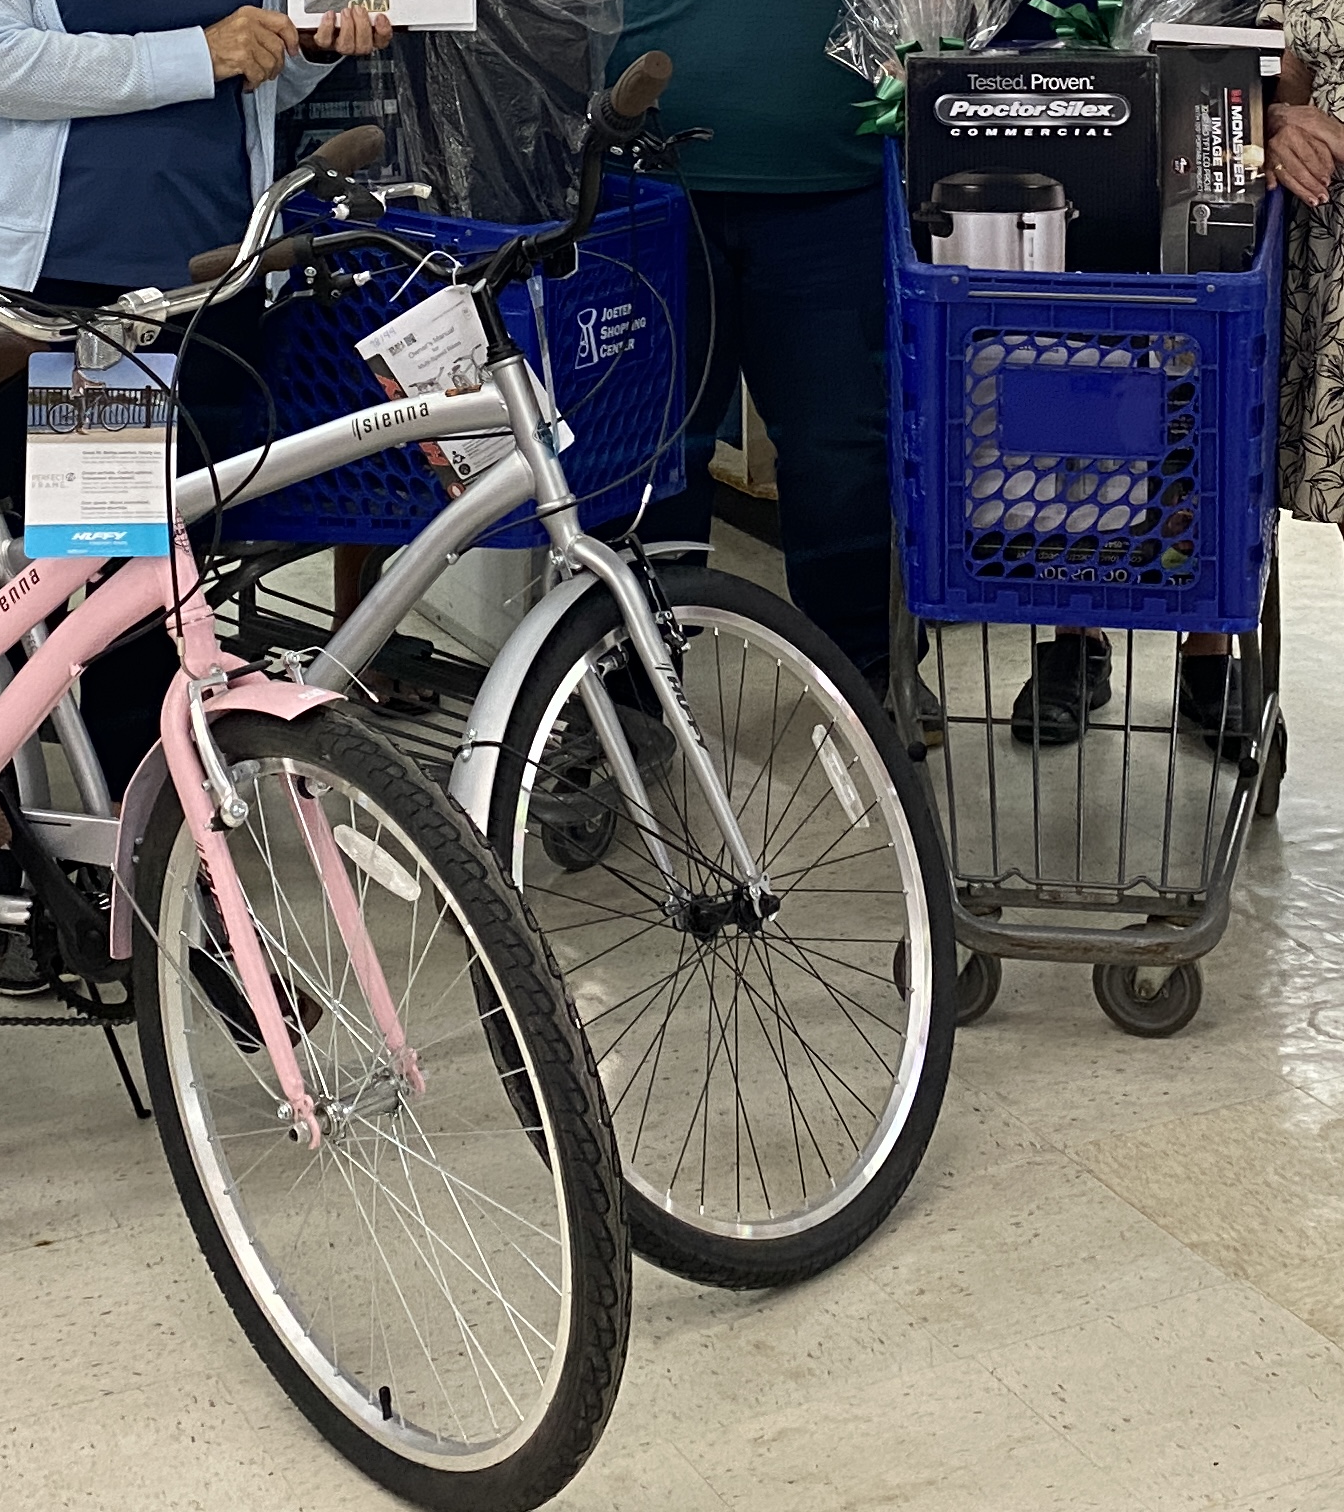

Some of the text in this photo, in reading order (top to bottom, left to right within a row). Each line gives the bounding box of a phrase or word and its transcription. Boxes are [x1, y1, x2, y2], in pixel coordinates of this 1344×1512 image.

[967, 74, 1027, 90] Tested.
[950, 128, 1112, 136] COMMERCIAL
[1211, 117, 1223, 166] IMAGE
[363, 402, 429, 433] sienna
[71, 532, 127, 541] HUFFY
